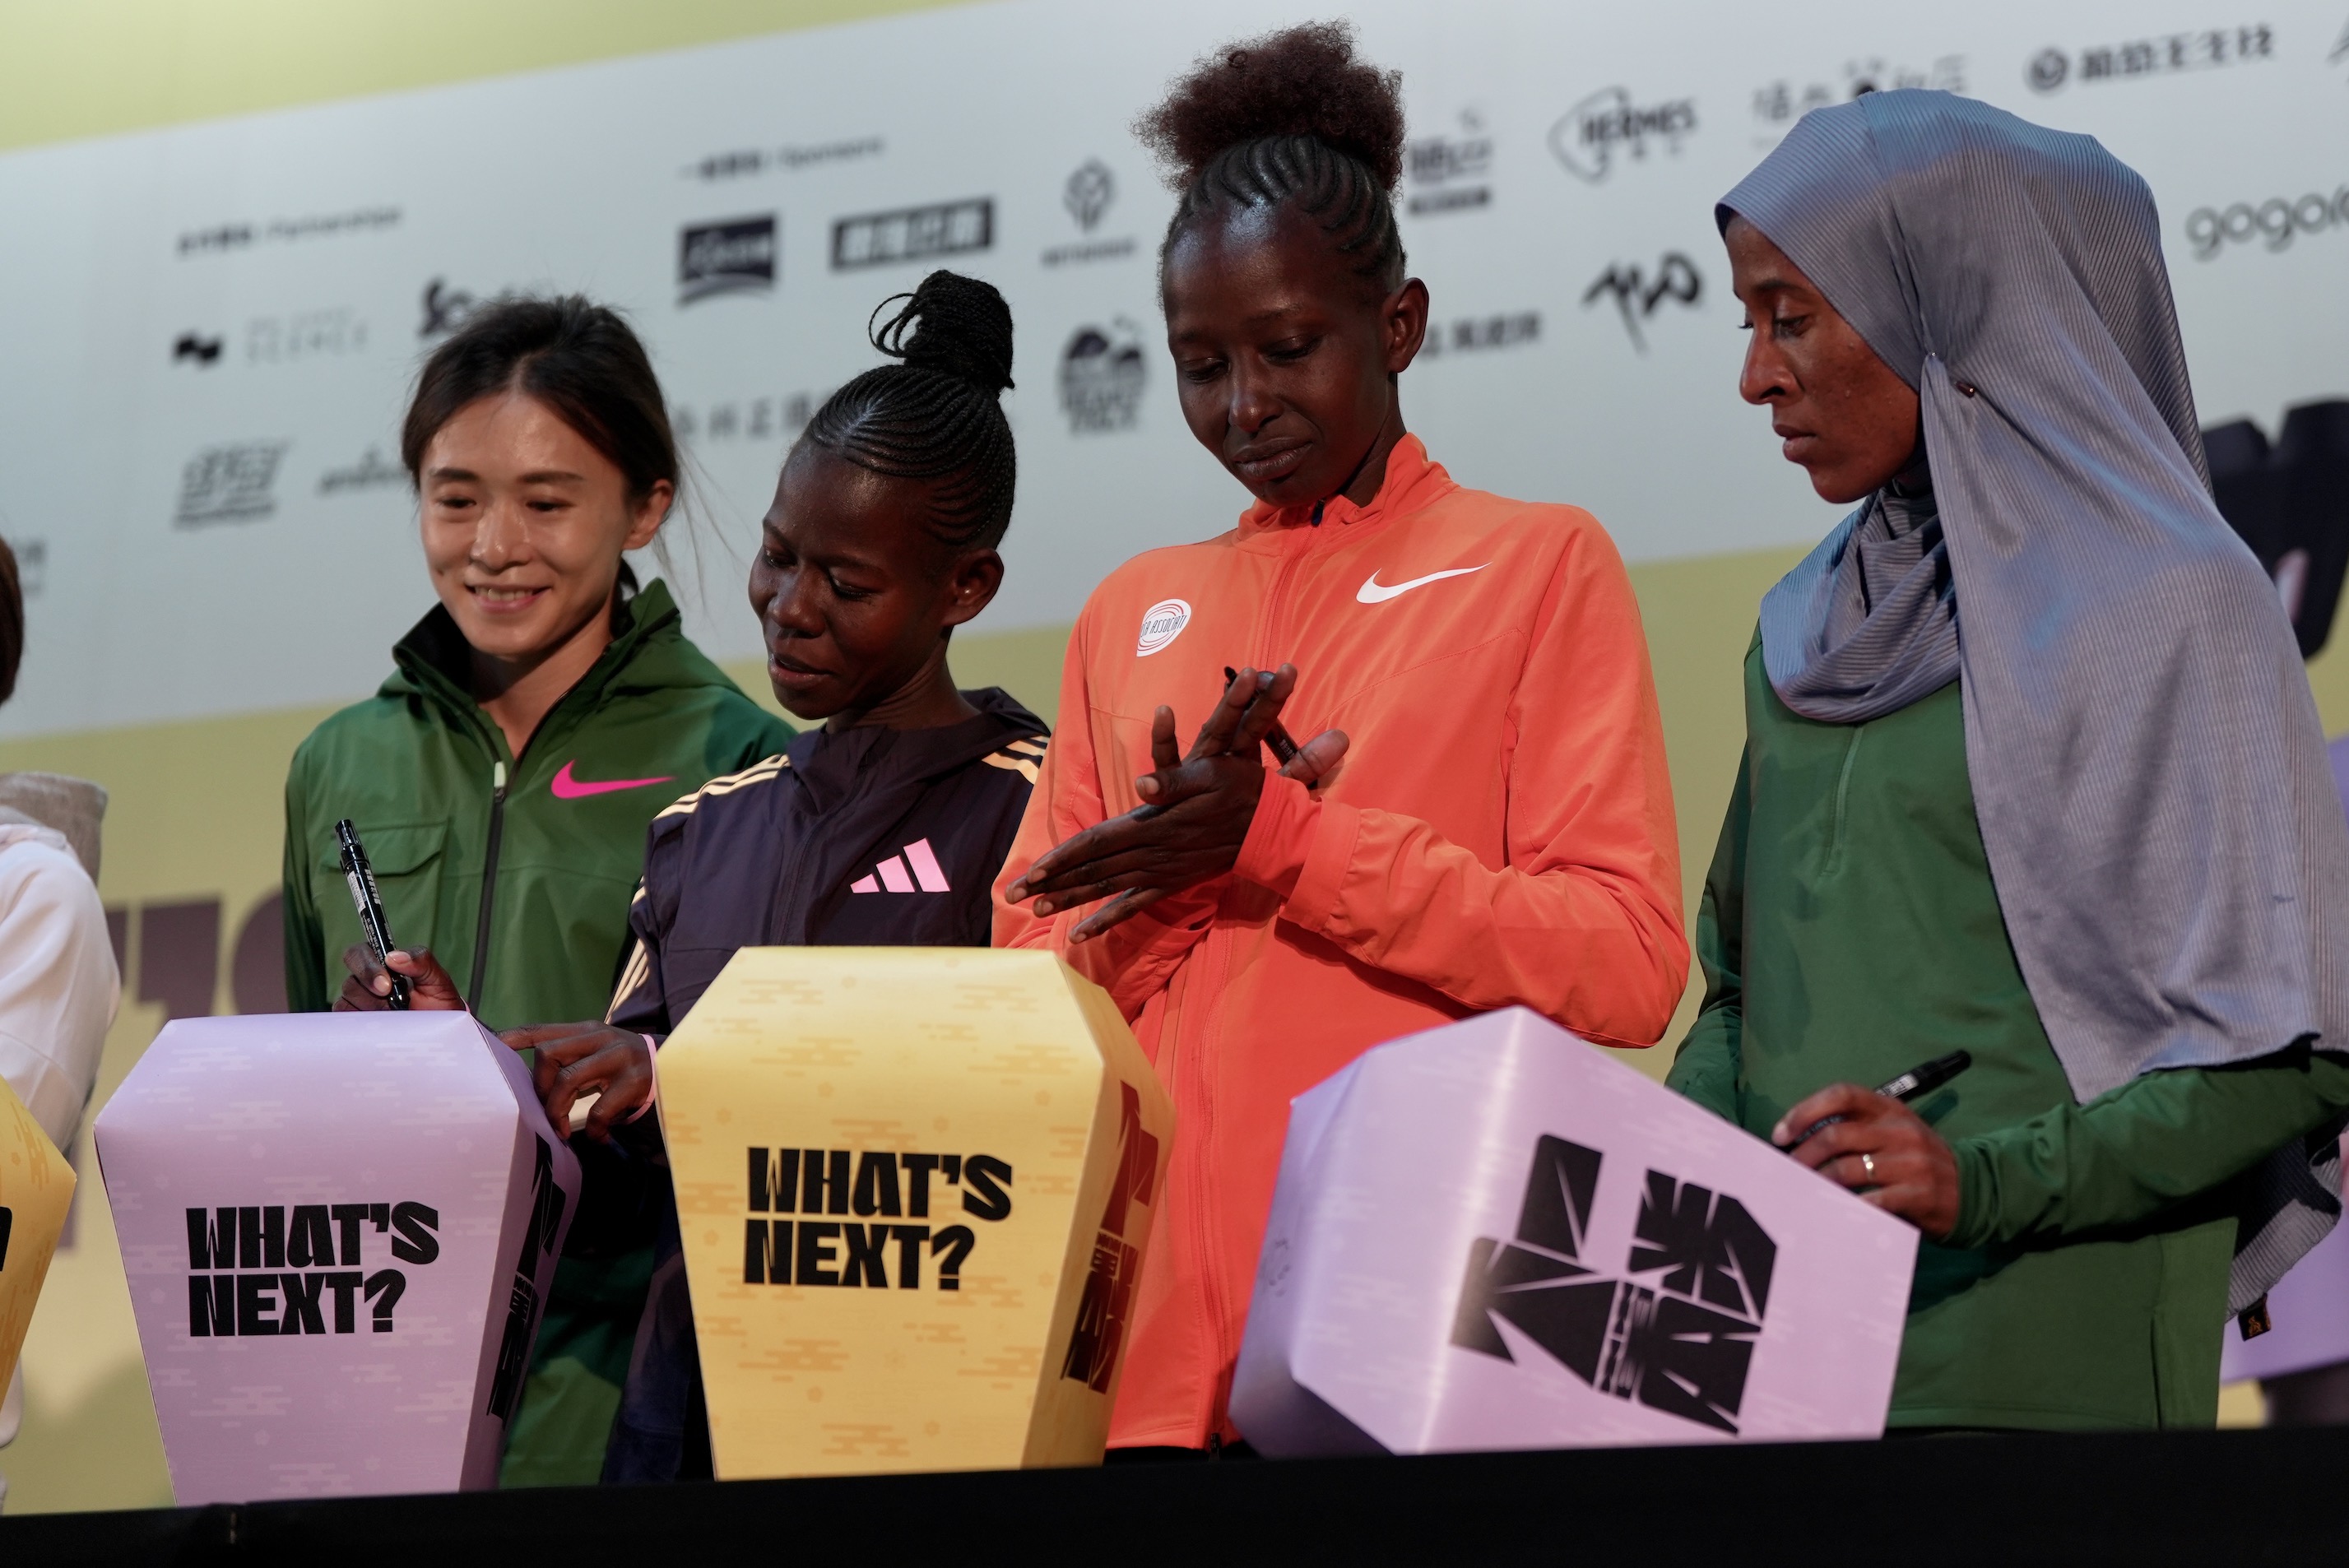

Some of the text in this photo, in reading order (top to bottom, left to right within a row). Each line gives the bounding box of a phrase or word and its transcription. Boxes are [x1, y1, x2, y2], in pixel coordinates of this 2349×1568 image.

[1578, 99, 1697, 146] HERMES
[2184, 186, 2349, 262] gogor
[748, 1147, 1012, 1222] WHAT'S
[186, 1201, 439, 1269] WHAT'S
[743, 1218, 976, 1291] NEXT?
[188, 1269, 406, 1337] NEXT?
